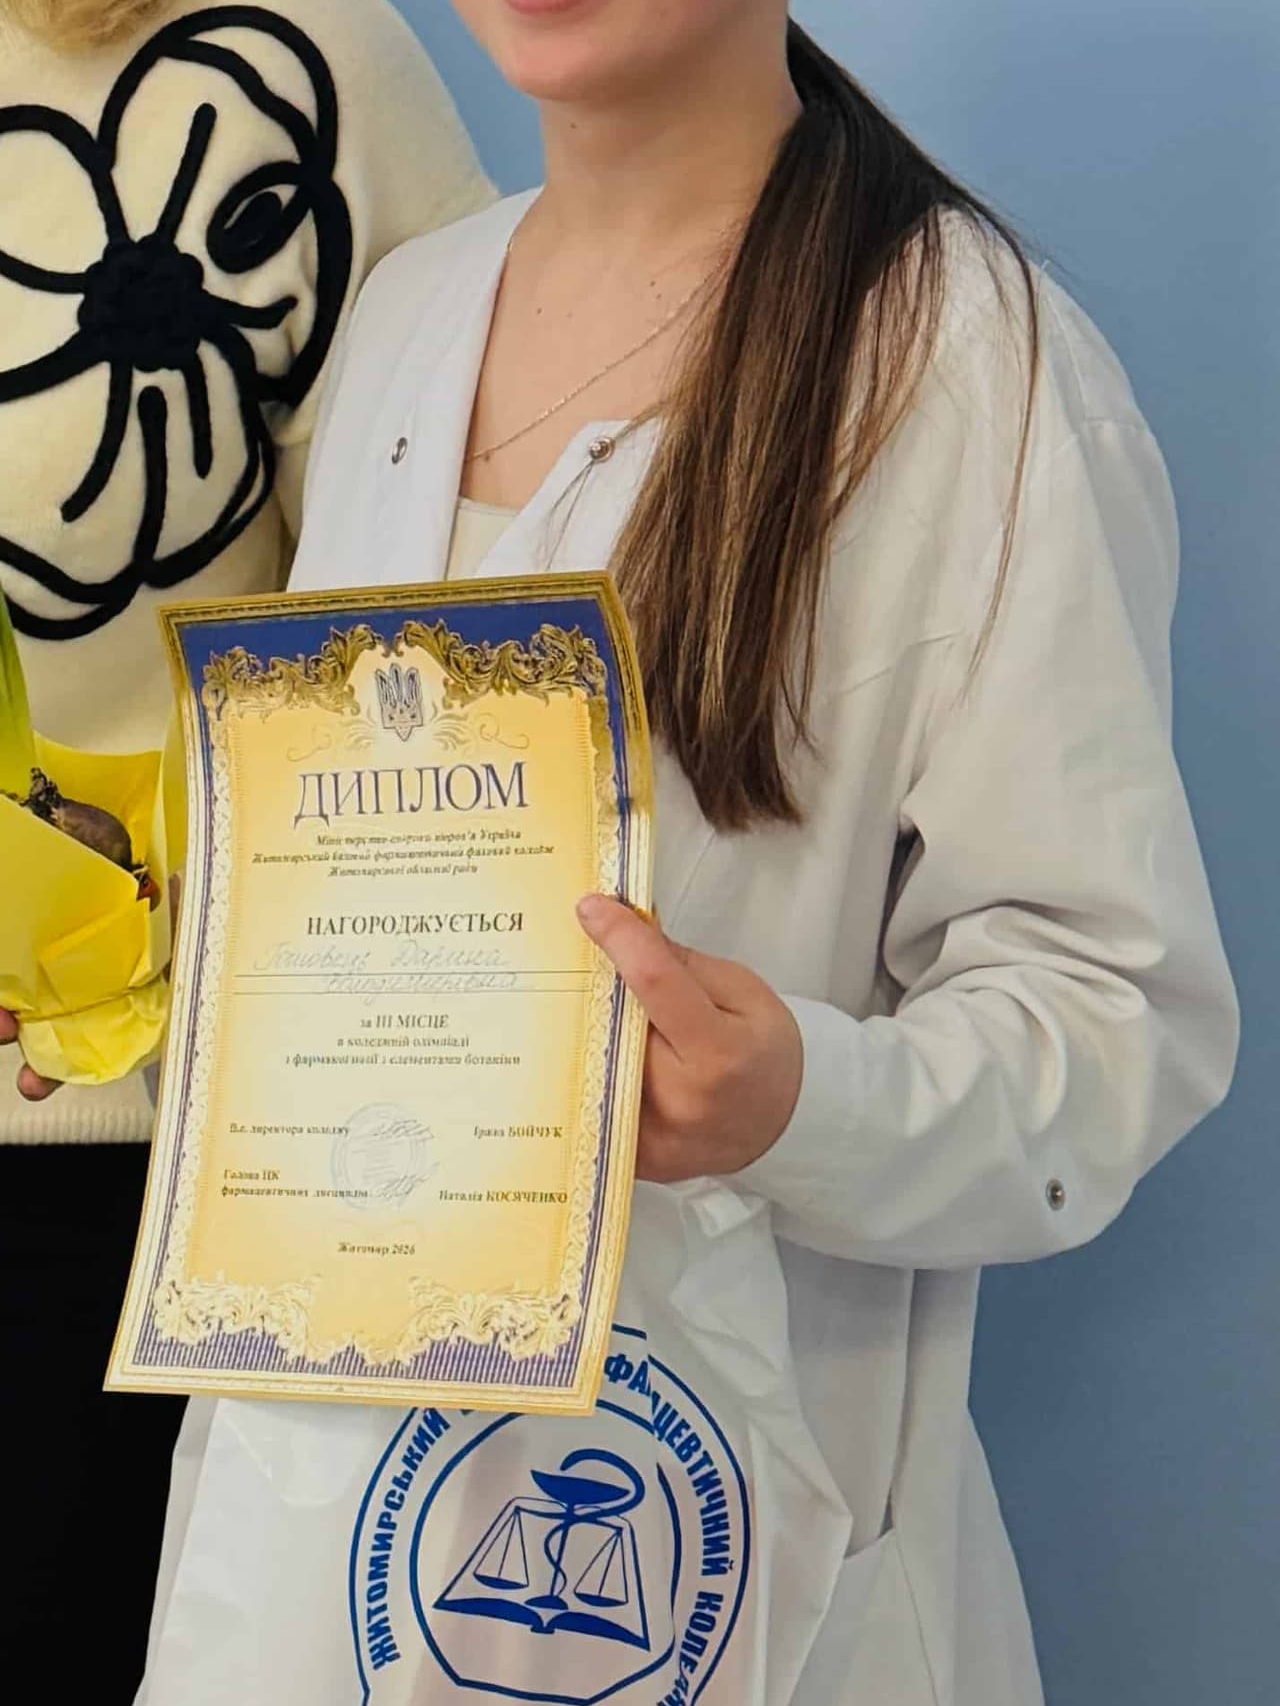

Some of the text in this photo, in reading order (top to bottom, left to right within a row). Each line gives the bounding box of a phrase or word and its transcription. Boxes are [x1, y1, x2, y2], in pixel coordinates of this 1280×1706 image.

[293, 761, 530, 830] ДИПЛОМ
[307, 911, 524, 937] НАГОРОДЖУЄТЬСЯ
[395, 1013, 450, 1029] МІСЦЕ
[484, 1191, 569, 1205] КОСЯЧЕНКО
